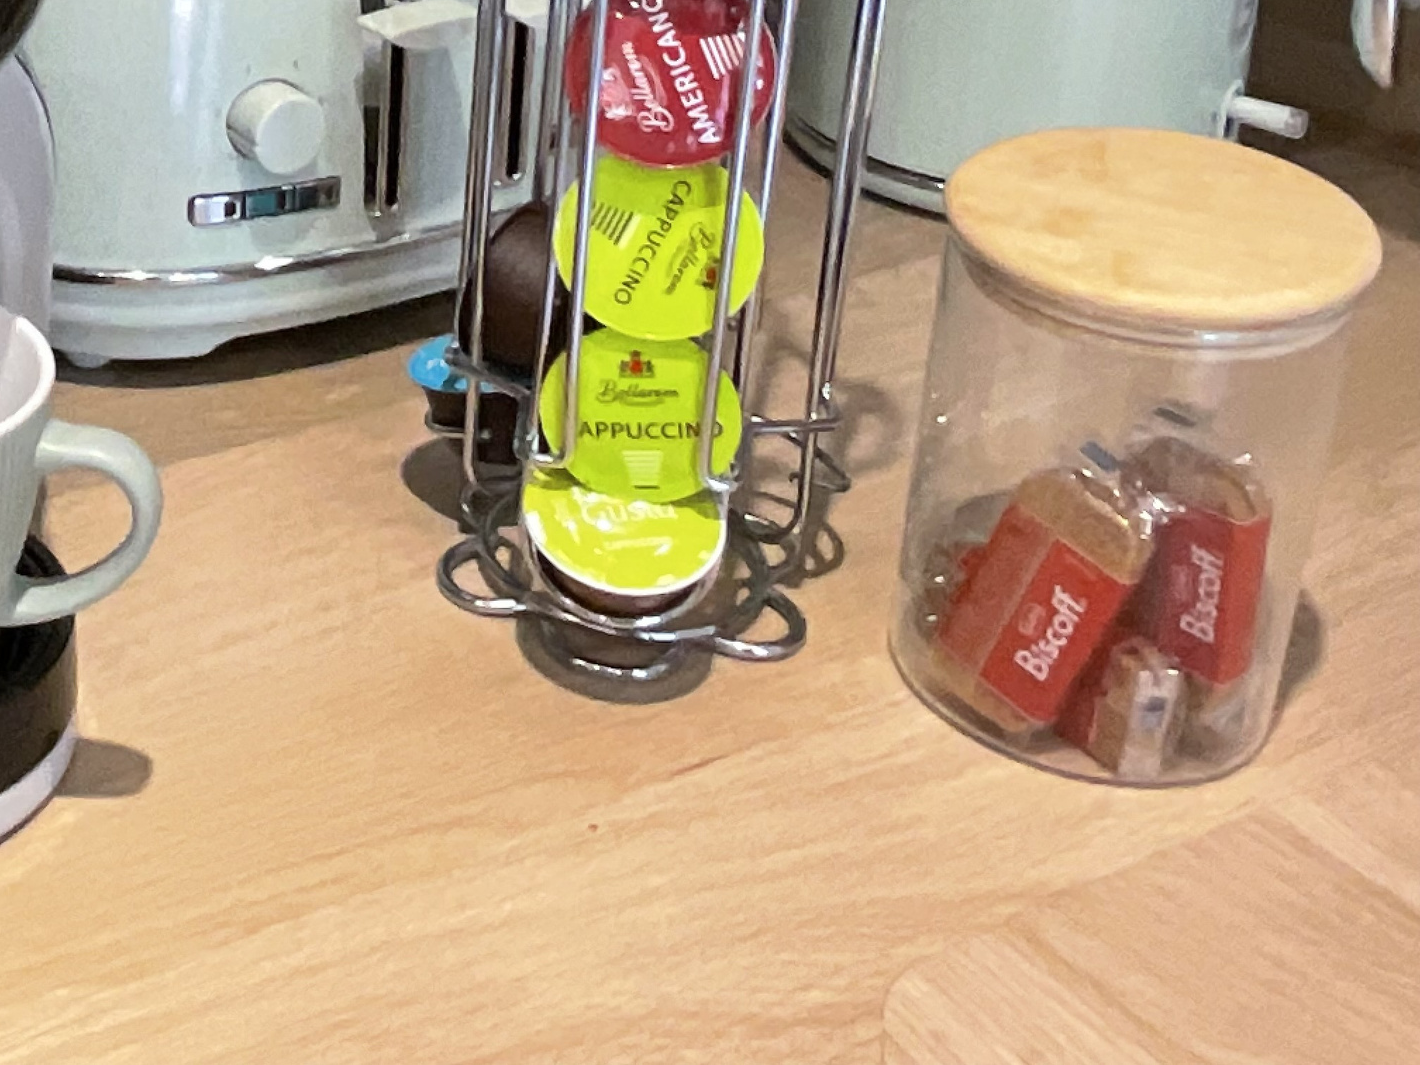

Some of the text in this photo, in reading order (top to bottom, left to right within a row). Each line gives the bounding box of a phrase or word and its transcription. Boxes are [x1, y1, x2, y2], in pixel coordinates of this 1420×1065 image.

[614, 180, 692, 305] CAPPUCCINO
[580, 421, 724, 441] APPUCCINO
[1014, 584, 1086, 682] Biscoff
[1179, 544, 1224, 644] Biscoff
